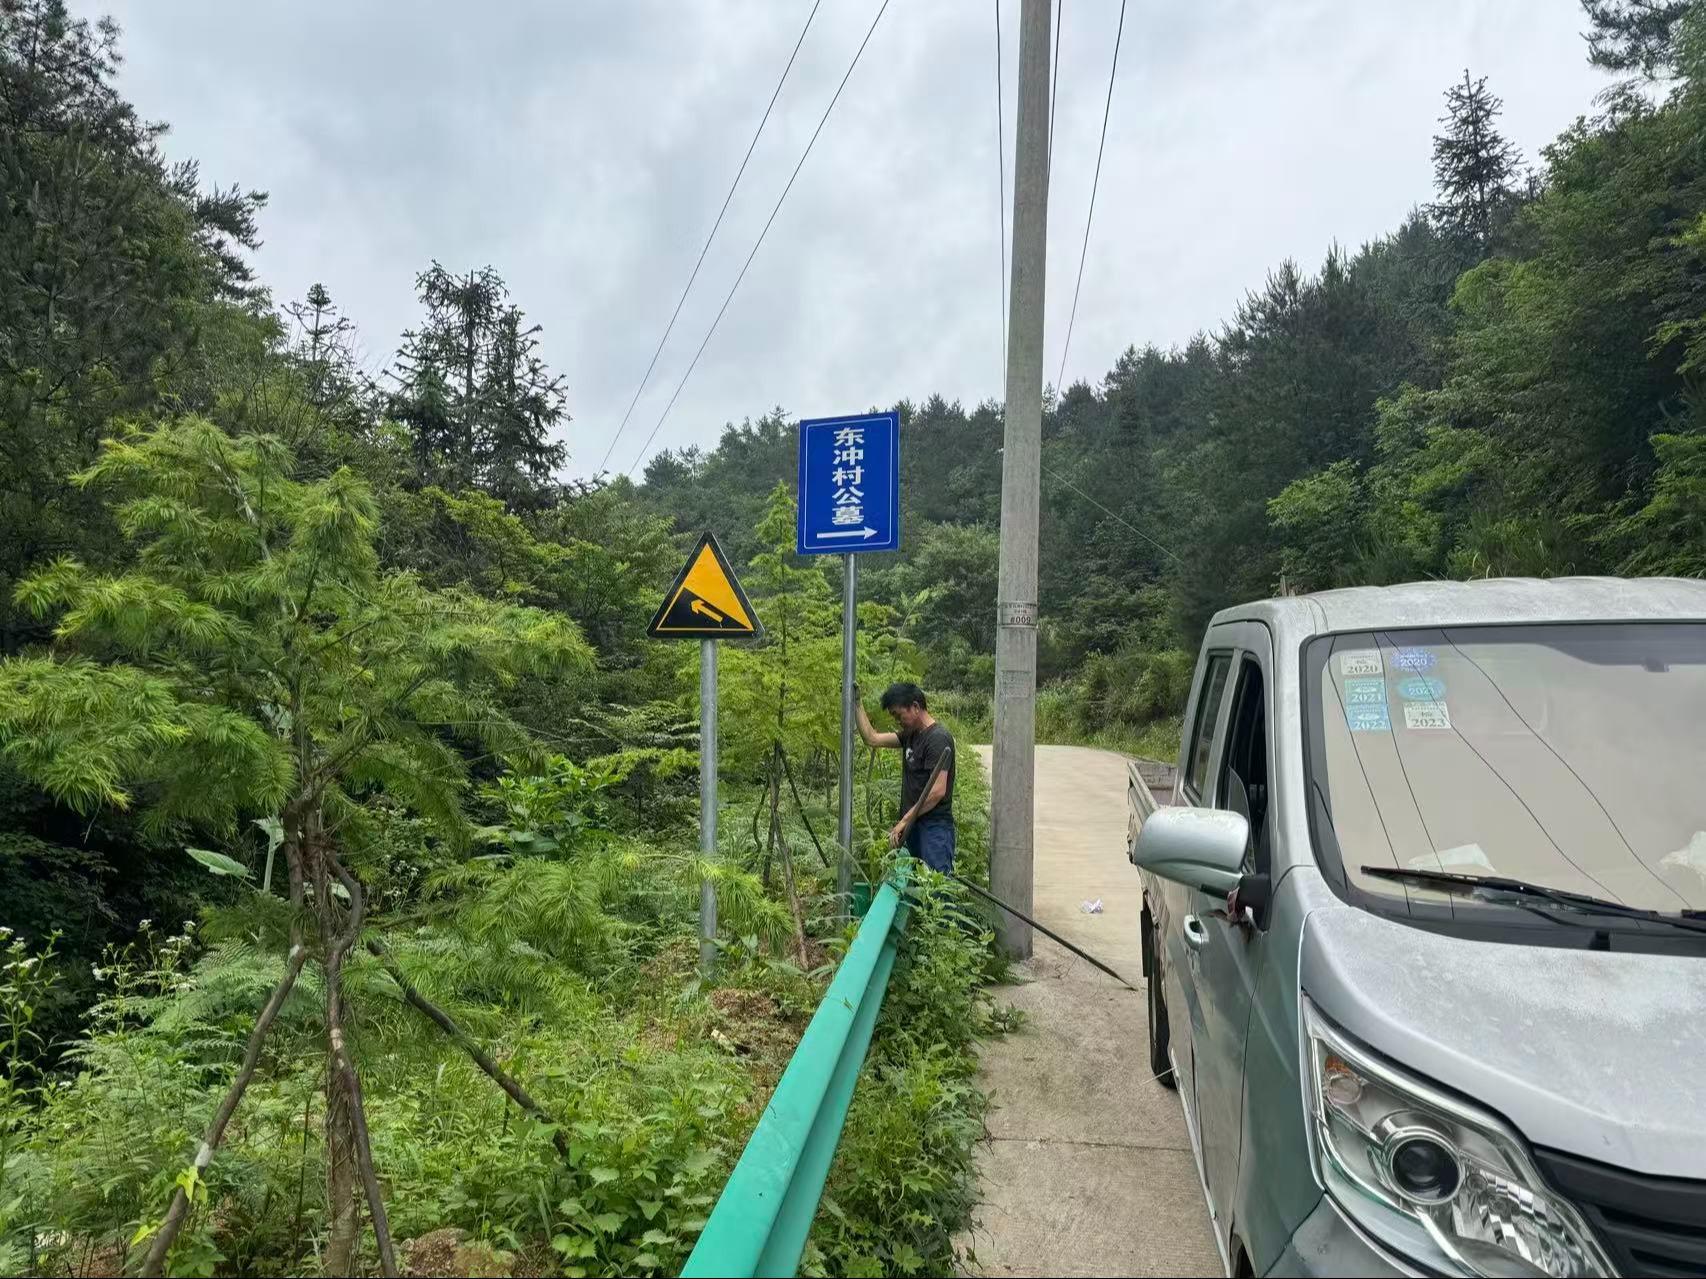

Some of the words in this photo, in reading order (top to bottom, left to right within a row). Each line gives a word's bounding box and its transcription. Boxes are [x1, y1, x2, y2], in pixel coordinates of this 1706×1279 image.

[832, 427, 865, 526] 东冲村公墓
[1400, 658, 1428, 667] 2020
[1347, 665, 1378, 674] 2020
[1351, 693, 1382, 703] 2021
[1354, 721, 1387, 730] 2022
[1411, 718, 1446, 728] 2023
